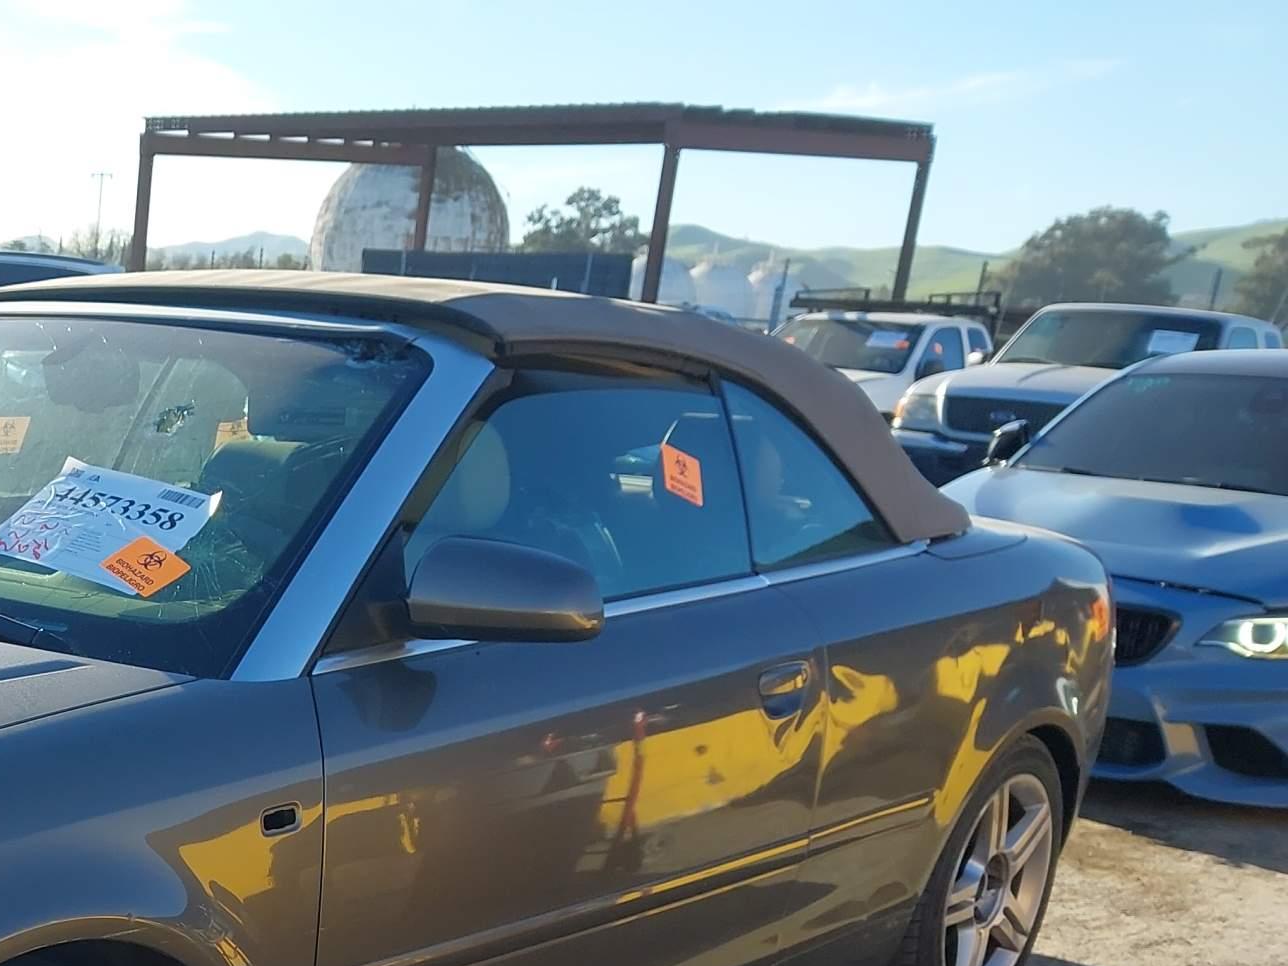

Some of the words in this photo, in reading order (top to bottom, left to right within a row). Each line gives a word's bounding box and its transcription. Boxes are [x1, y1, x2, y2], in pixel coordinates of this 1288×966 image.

[55, 486, 185, 530] 44573358
[105, 563, 145, 592] BIOPELIGRO
[115, 558, 154, 586] BIOHAZARD
